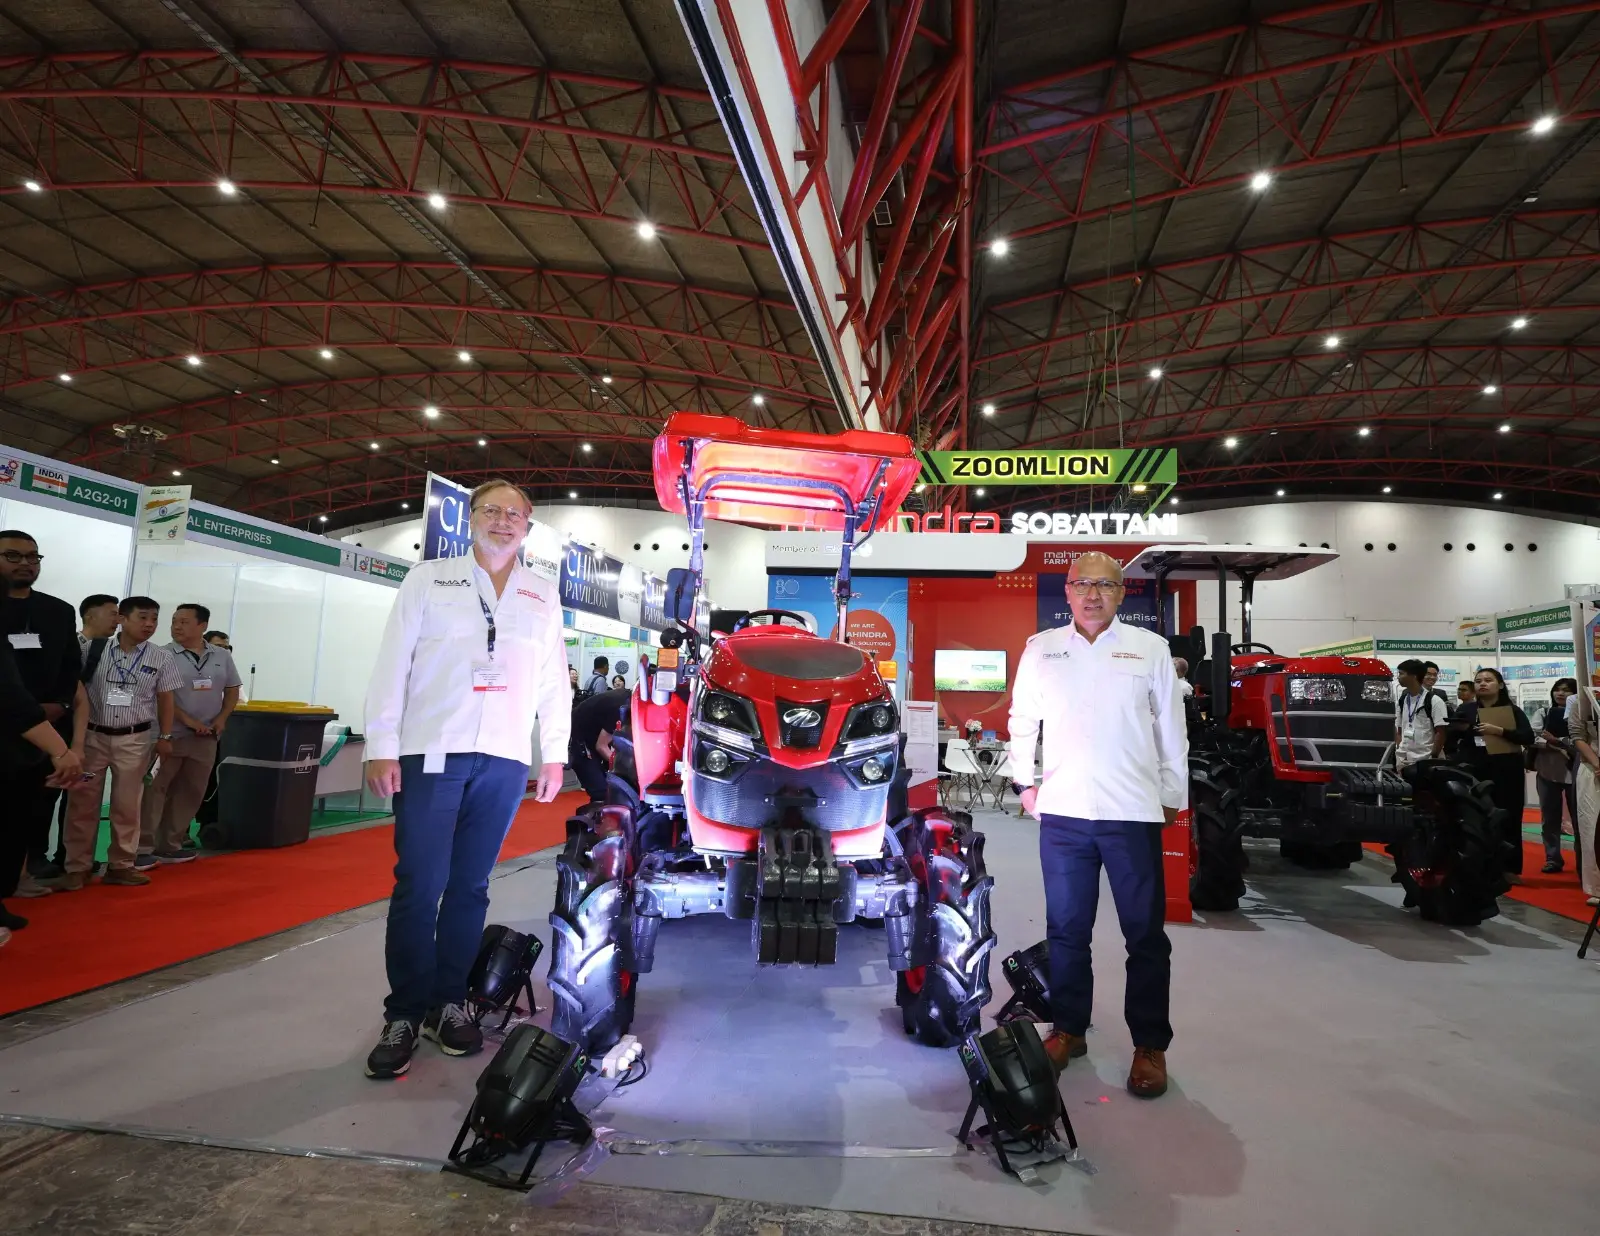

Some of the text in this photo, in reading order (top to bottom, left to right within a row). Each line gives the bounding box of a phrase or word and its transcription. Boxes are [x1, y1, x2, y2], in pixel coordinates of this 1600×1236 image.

[39, 468, 64, 480] INDIA
[952, 456, 1110, 477] ZOOMLION
[72, 486, 128, 509] A2G2-01
[203, 519, 272, 545] ENTERPRISES
[772, 545, 807, 553] Member
[1044, 550, 1089, 558] mahin
[566, 548, 609, 589] CHINA
[565, 579, 609, 609] PAVILION
[1505, 618, 1528, 629] GEOLIFE
[1528, 612, 1557, 624] AGRITECH
